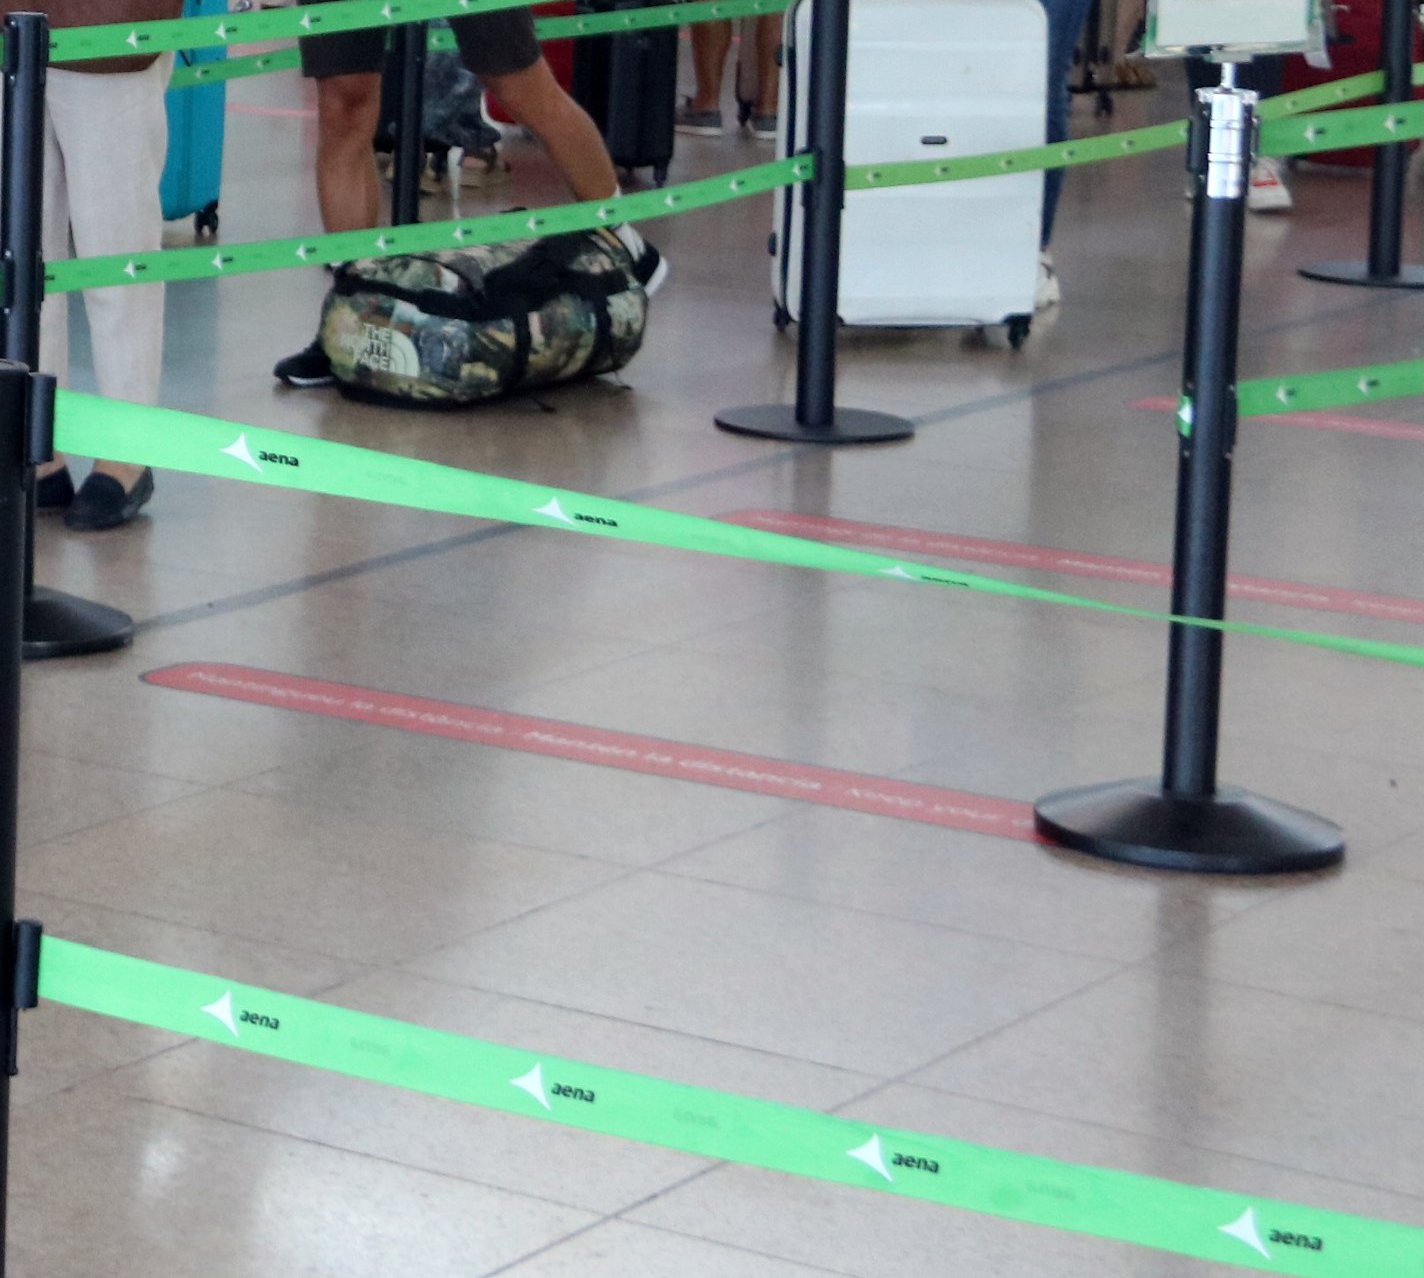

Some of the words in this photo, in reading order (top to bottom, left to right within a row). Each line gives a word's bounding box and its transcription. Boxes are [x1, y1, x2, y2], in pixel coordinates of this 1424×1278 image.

[363, 322, 392, 341] THE
[359, 352, 390, 371] ACE
[258, 451, 300, 467] aena
[573, 513, 618, 528] aena
[238, 1010, 280, 1031] aena
[550, 1083, 596, 1104] aena
[891, 1153, 940, 1174] aena
[1268, 1229, 1323, 1251] aena
